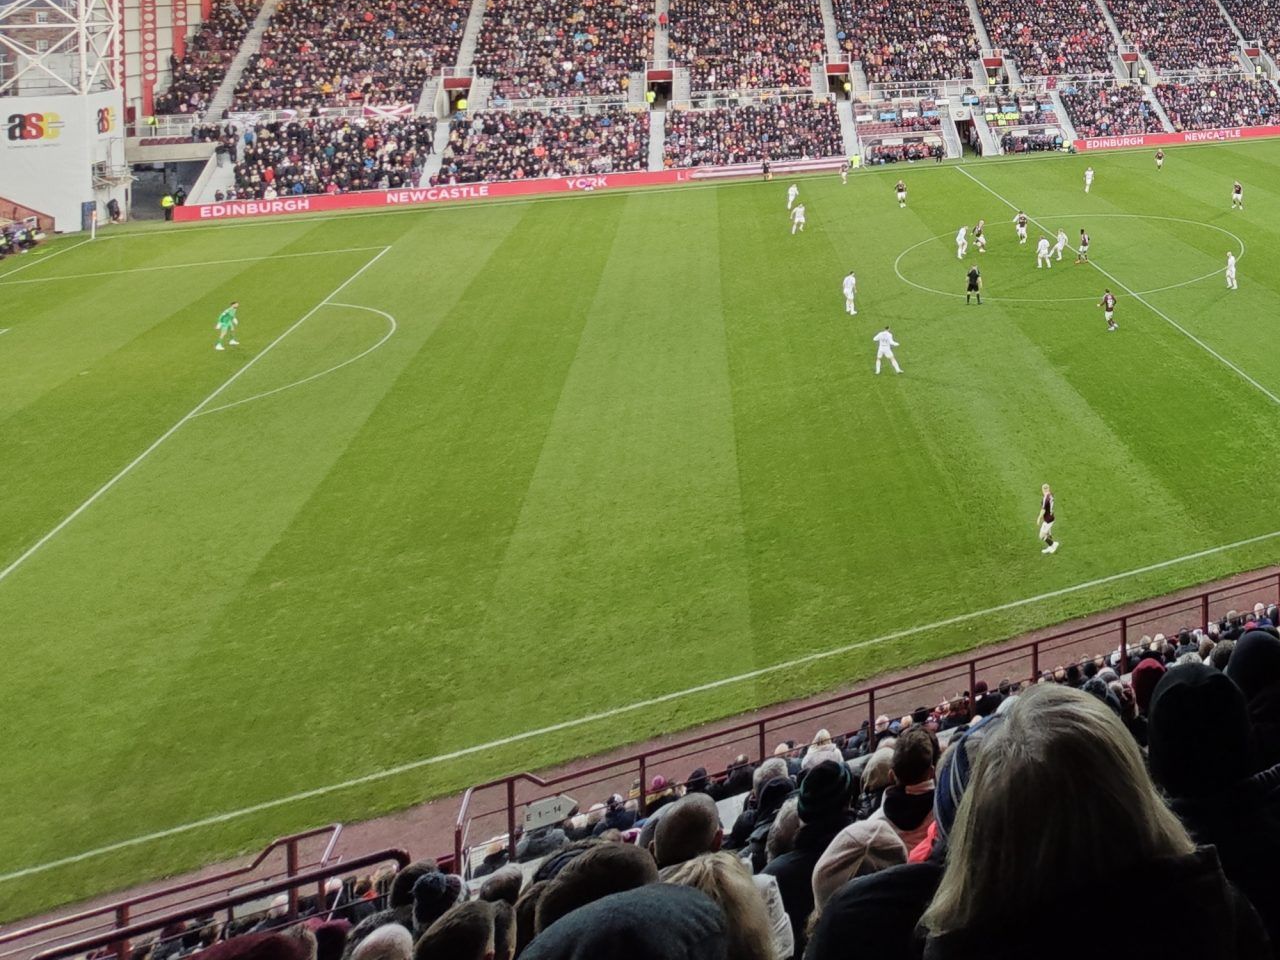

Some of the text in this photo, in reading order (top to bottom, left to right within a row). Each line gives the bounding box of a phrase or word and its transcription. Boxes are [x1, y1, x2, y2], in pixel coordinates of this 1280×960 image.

[1086, 136, 1144, 149] EDINBURGH
[1185, 129, 1241, 141] NEWCATLE
[200, 199, 309, 218] EDINBURGH
[386, 186, 489, 203] NEWCASTLE
[566, 176, 607, 189] YORK
[526, 814, 532, 822] E
